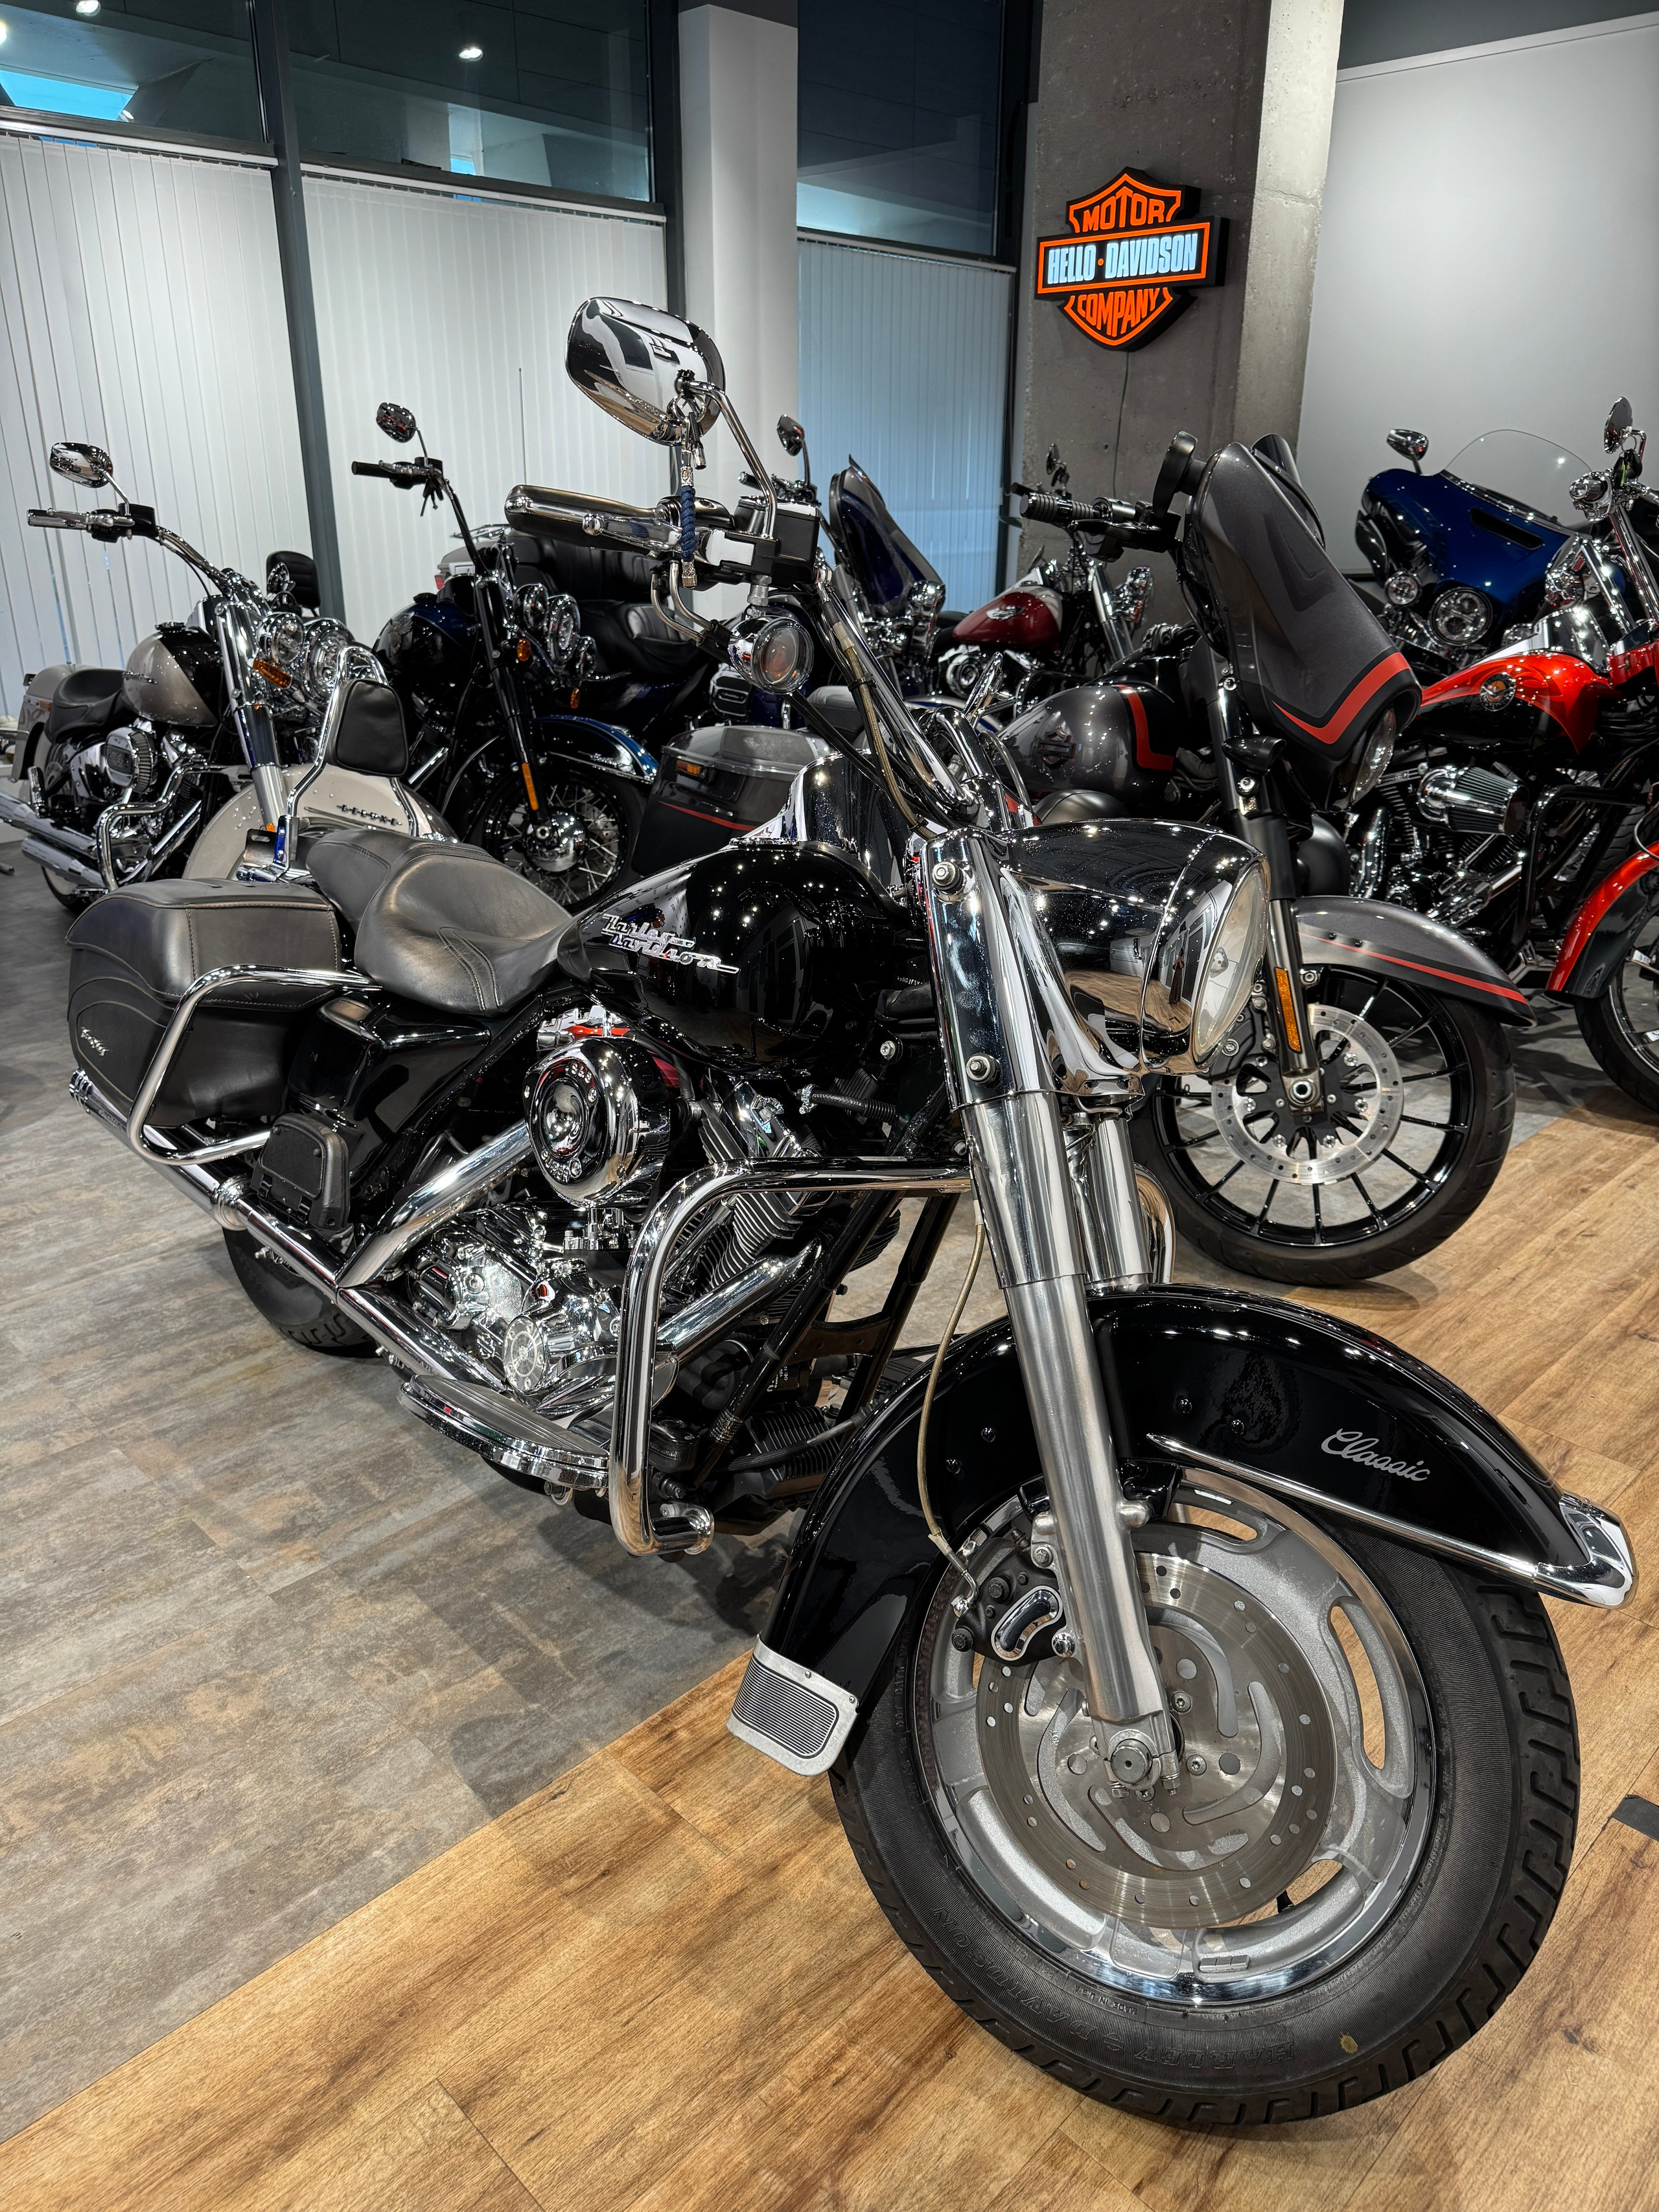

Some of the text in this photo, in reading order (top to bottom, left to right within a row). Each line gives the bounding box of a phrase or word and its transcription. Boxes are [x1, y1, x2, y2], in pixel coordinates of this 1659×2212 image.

[1083, 186, 1165, 232] MOTOR
[1047, 233, 1198, 285] HELLO DAVIDSON
[1077, 288, 1160, 337] COMPANY
[1321, 1428, 1431, 1482] Classic
[933, 1905, 1297, 2069] HARLEY DAVIDSON
[1099, 1996, 1109, 2006] IN
[1113, 2001, 1138, 2016] MADE
